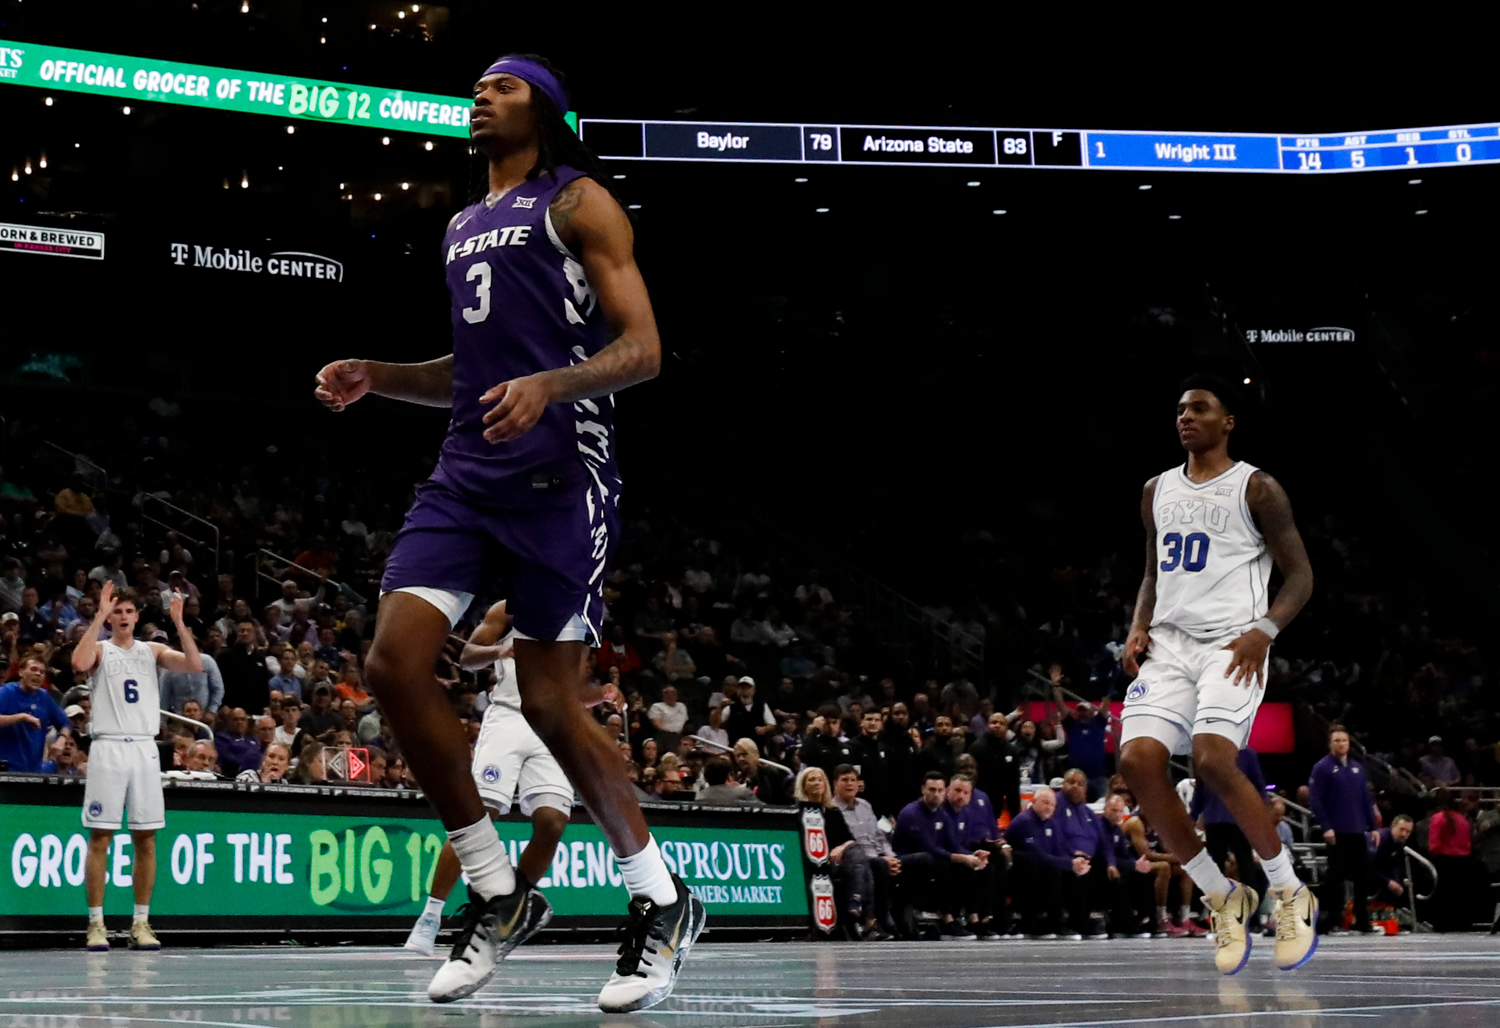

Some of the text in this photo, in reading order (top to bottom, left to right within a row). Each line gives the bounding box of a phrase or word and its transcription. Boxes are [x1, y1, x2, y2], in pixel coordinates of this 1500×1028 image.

[40, 59, 127, 88] OFFICIAL
[133, 70, 210, 97] GROCER
[216, 77, 241, 101] OF
[247, 81, 285, 105] THE
[288, 85, 340, 119] BIG
[347, 91, 371, 120] 12
[697, 131, 749, 152] Baylor
[810, 134, 832, 150] 79
[863, 135, 973, 154] Arizona State
[1003, 138, 1027, 155] 83
[1052, 132, 1063, 147] F
[1296, 138, 1320, 148] PTS
[1344, 135, 1367, 146] AST
[1448, 129, 1471, 139] STL
[1096, 141, 1106, 158] 1
[1155, 143, 1237, 163] Wright III
[1298, 144, 1471, 170] 14 5 1 0
[29, 231, 38, 241] &
[41, 232, 95, 247] BREWED
[446, 225, 532, 265] K-STATE
[193, 245, 263, 273] Mobile
[267, 258, 337, 280] CENTER
[462, 261, 492, 324] 3
[1261, 329, 1303, 343] Mobile
[1306, 331, 1350, 343] CENTER
[1158, 500, 1230, 533] BYU
[1160, 532, 1210, 572] 30
[124, 679, 139, 703] 6
[809, 832, 824, 853] 66
[171, 833, 214, 885] OF
[226, 832, 294, 884] THE
[309, 825, 394, 906] BIG
[661, 841, 786, 880] SPROUTS
[731, 885, 783, 903] MARKET
[818, 898, 833, 920] 66
